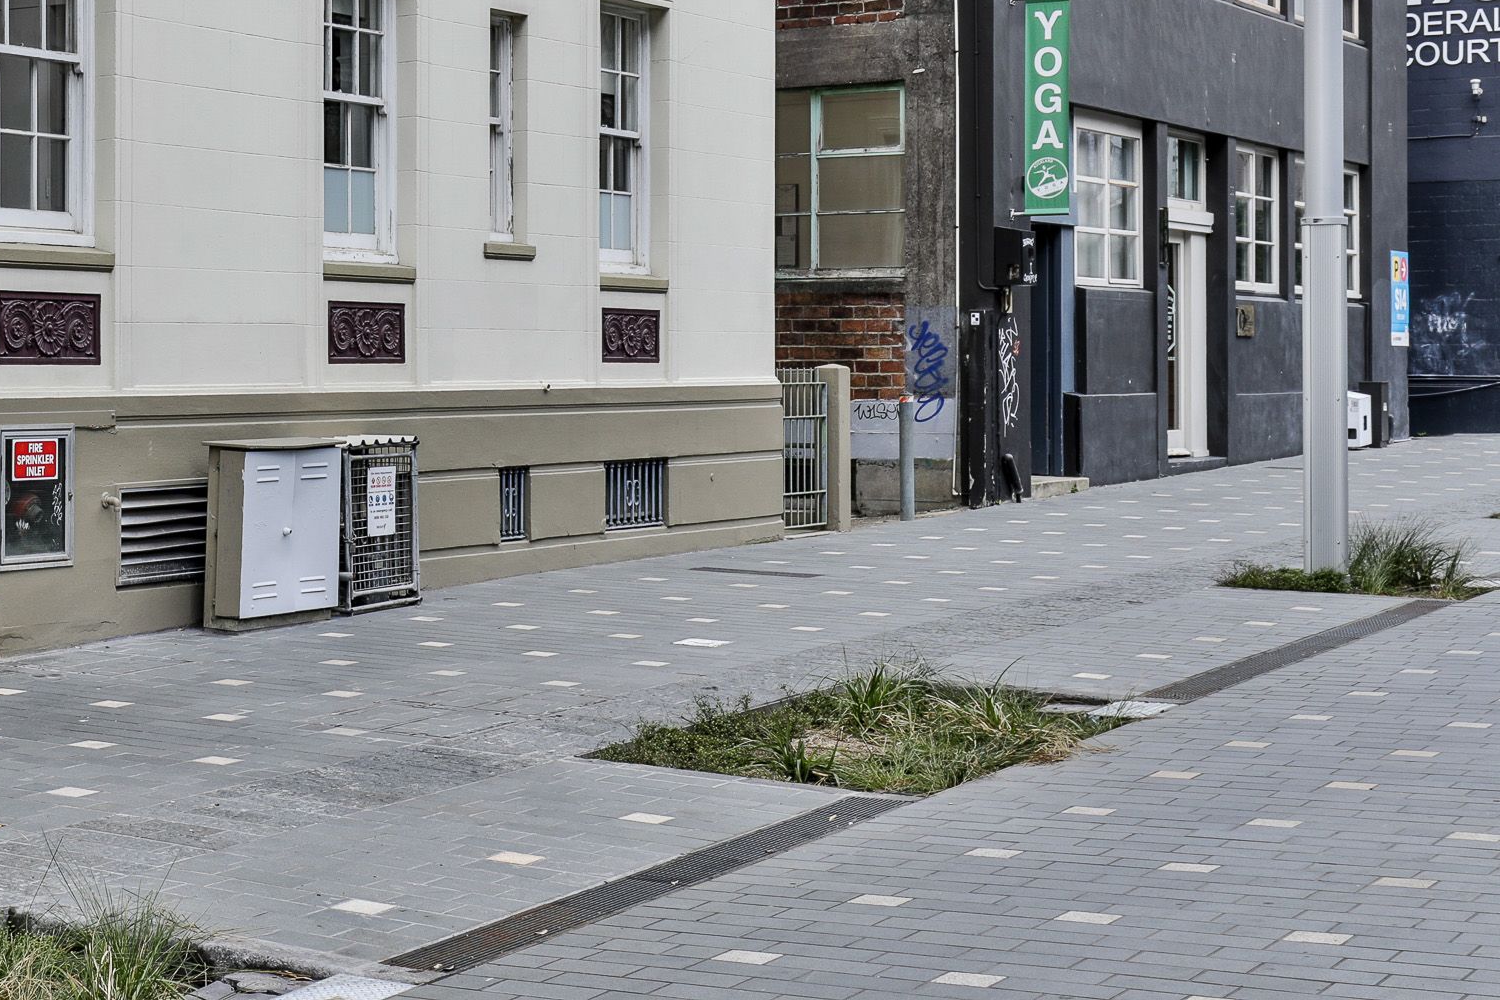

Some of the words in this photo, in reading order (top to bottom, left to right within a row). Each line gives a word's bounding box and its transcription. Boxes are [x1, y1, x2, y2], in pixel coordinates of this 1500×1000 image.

[1032, 10, 1063, 150] YOGA
[28, 443, 43, 453] FIRE
[17, 454, 54, 465] SPRINKLER
[26, 466, 45, 477] INLET
